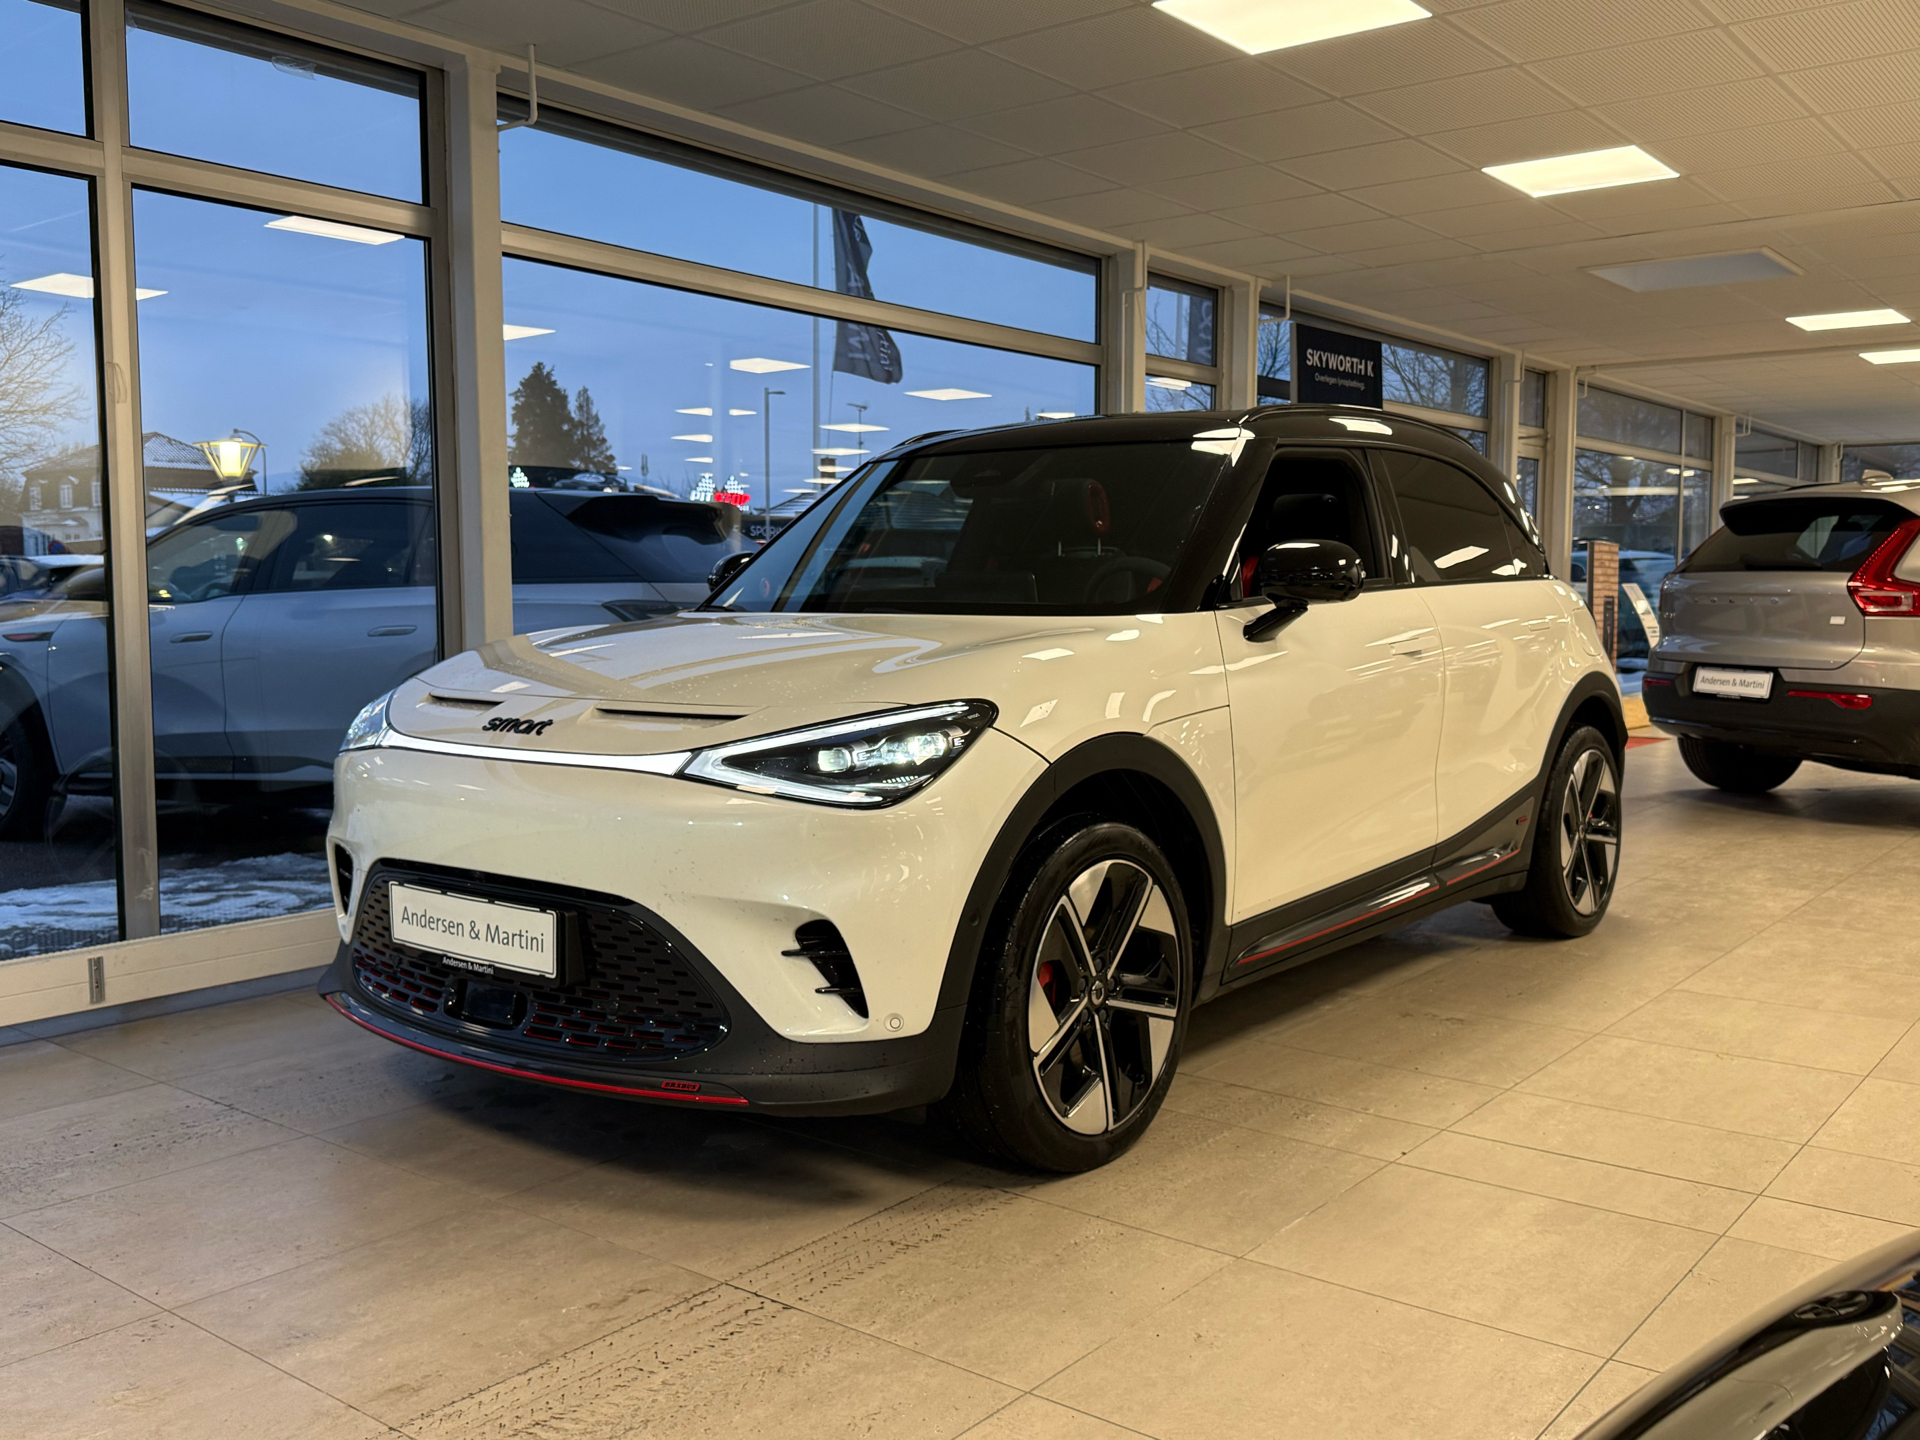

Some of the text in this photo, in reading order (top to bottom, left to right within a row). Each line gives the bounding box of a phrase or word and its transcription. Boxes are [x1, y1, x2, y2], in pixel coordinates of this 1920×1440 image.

[1306, 348, 1374, 377] SKYWORTH K
[1699, 675, 1766, 690] Andersen & Martini
[481, 716, 554, 736] smart
[401, 905, 546, 954] Andersen & Martini
[442, 956, 467, 969] Andersen
[473, 963, 494, 974] Martini
